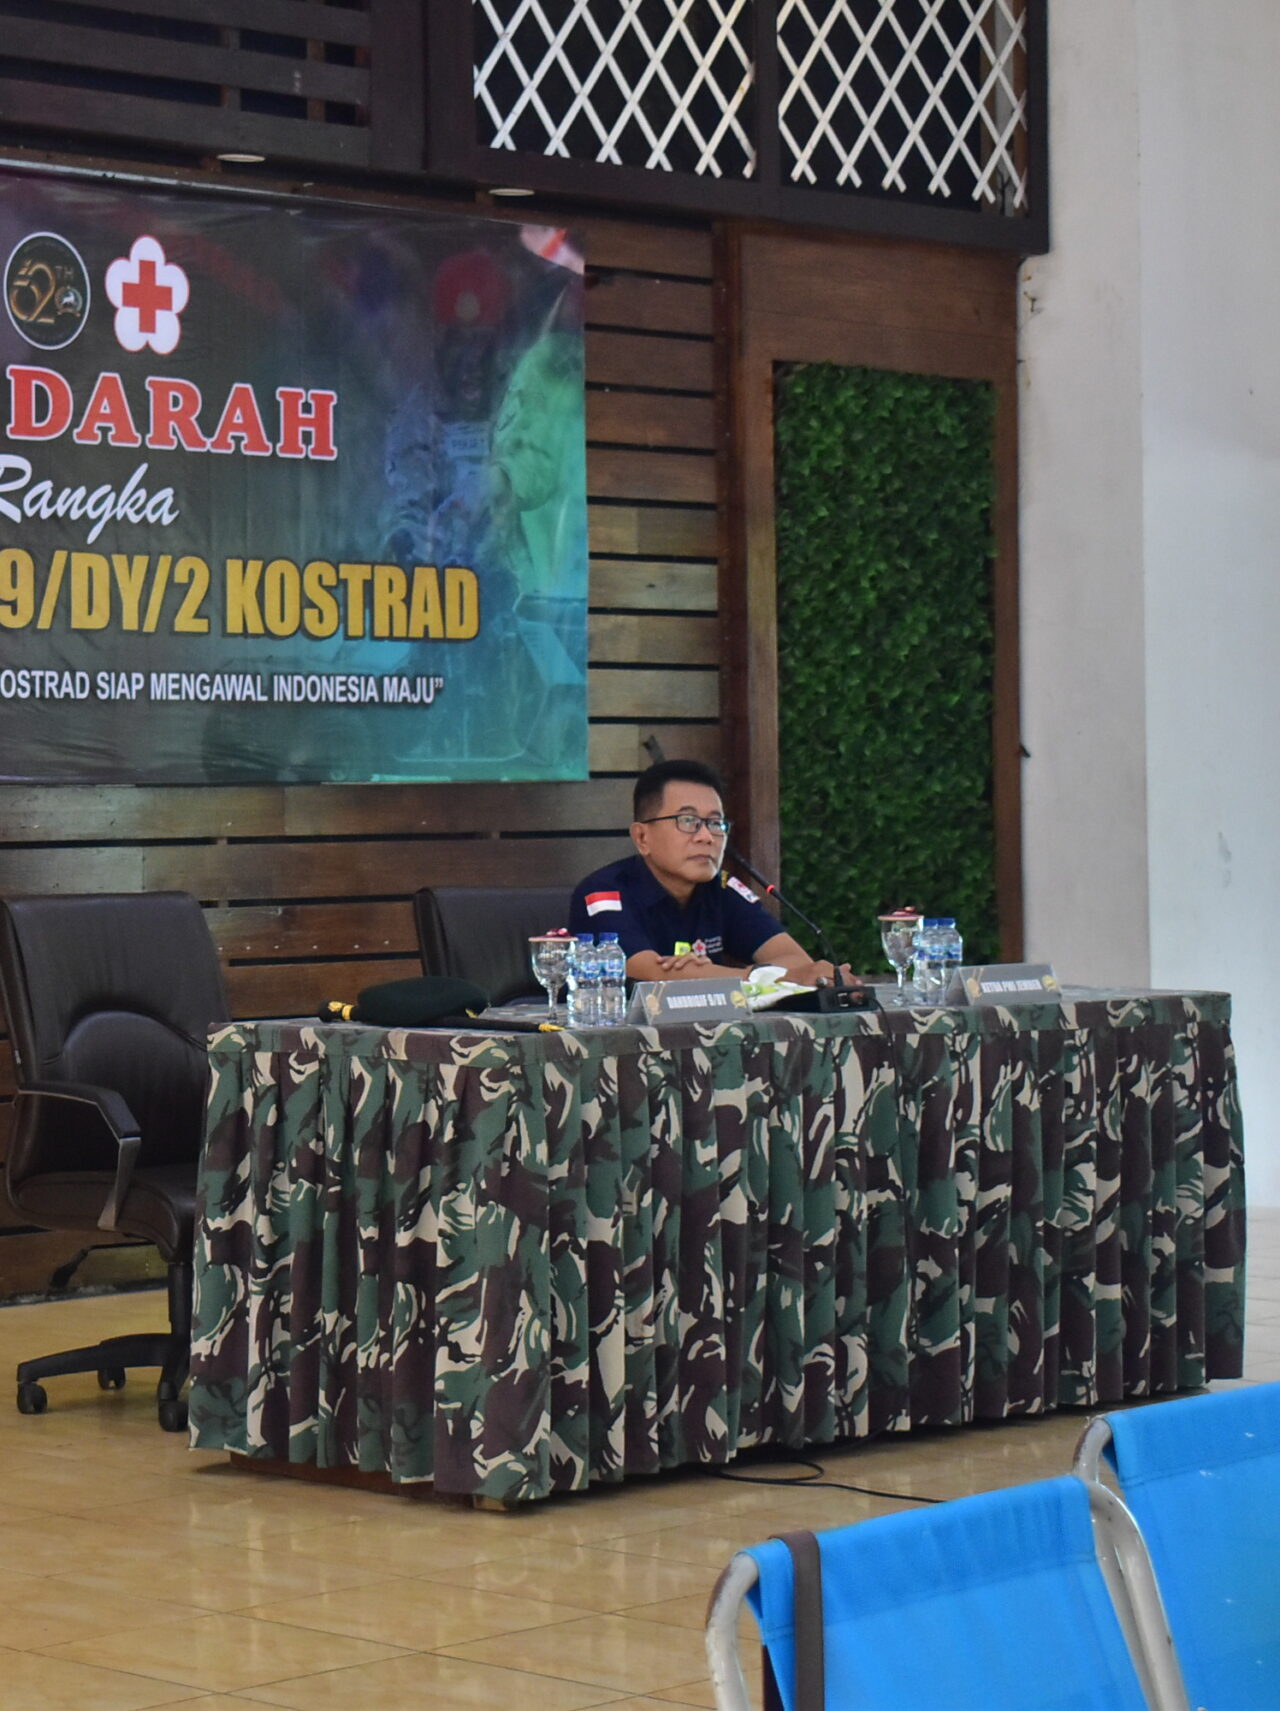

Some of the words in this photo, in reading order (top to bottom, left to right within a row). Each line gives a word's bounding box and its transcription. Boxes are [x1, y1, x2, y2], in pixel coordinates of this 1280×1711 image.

[6, 365, 338, 461] DARAH
[226, 558, 480, 640] KOSTRAD
[96, 671, 144, 700] SIAP
[150, 672, 268, 702] MENGAWAL
[273, 674, 379, 702] INDONESIA
